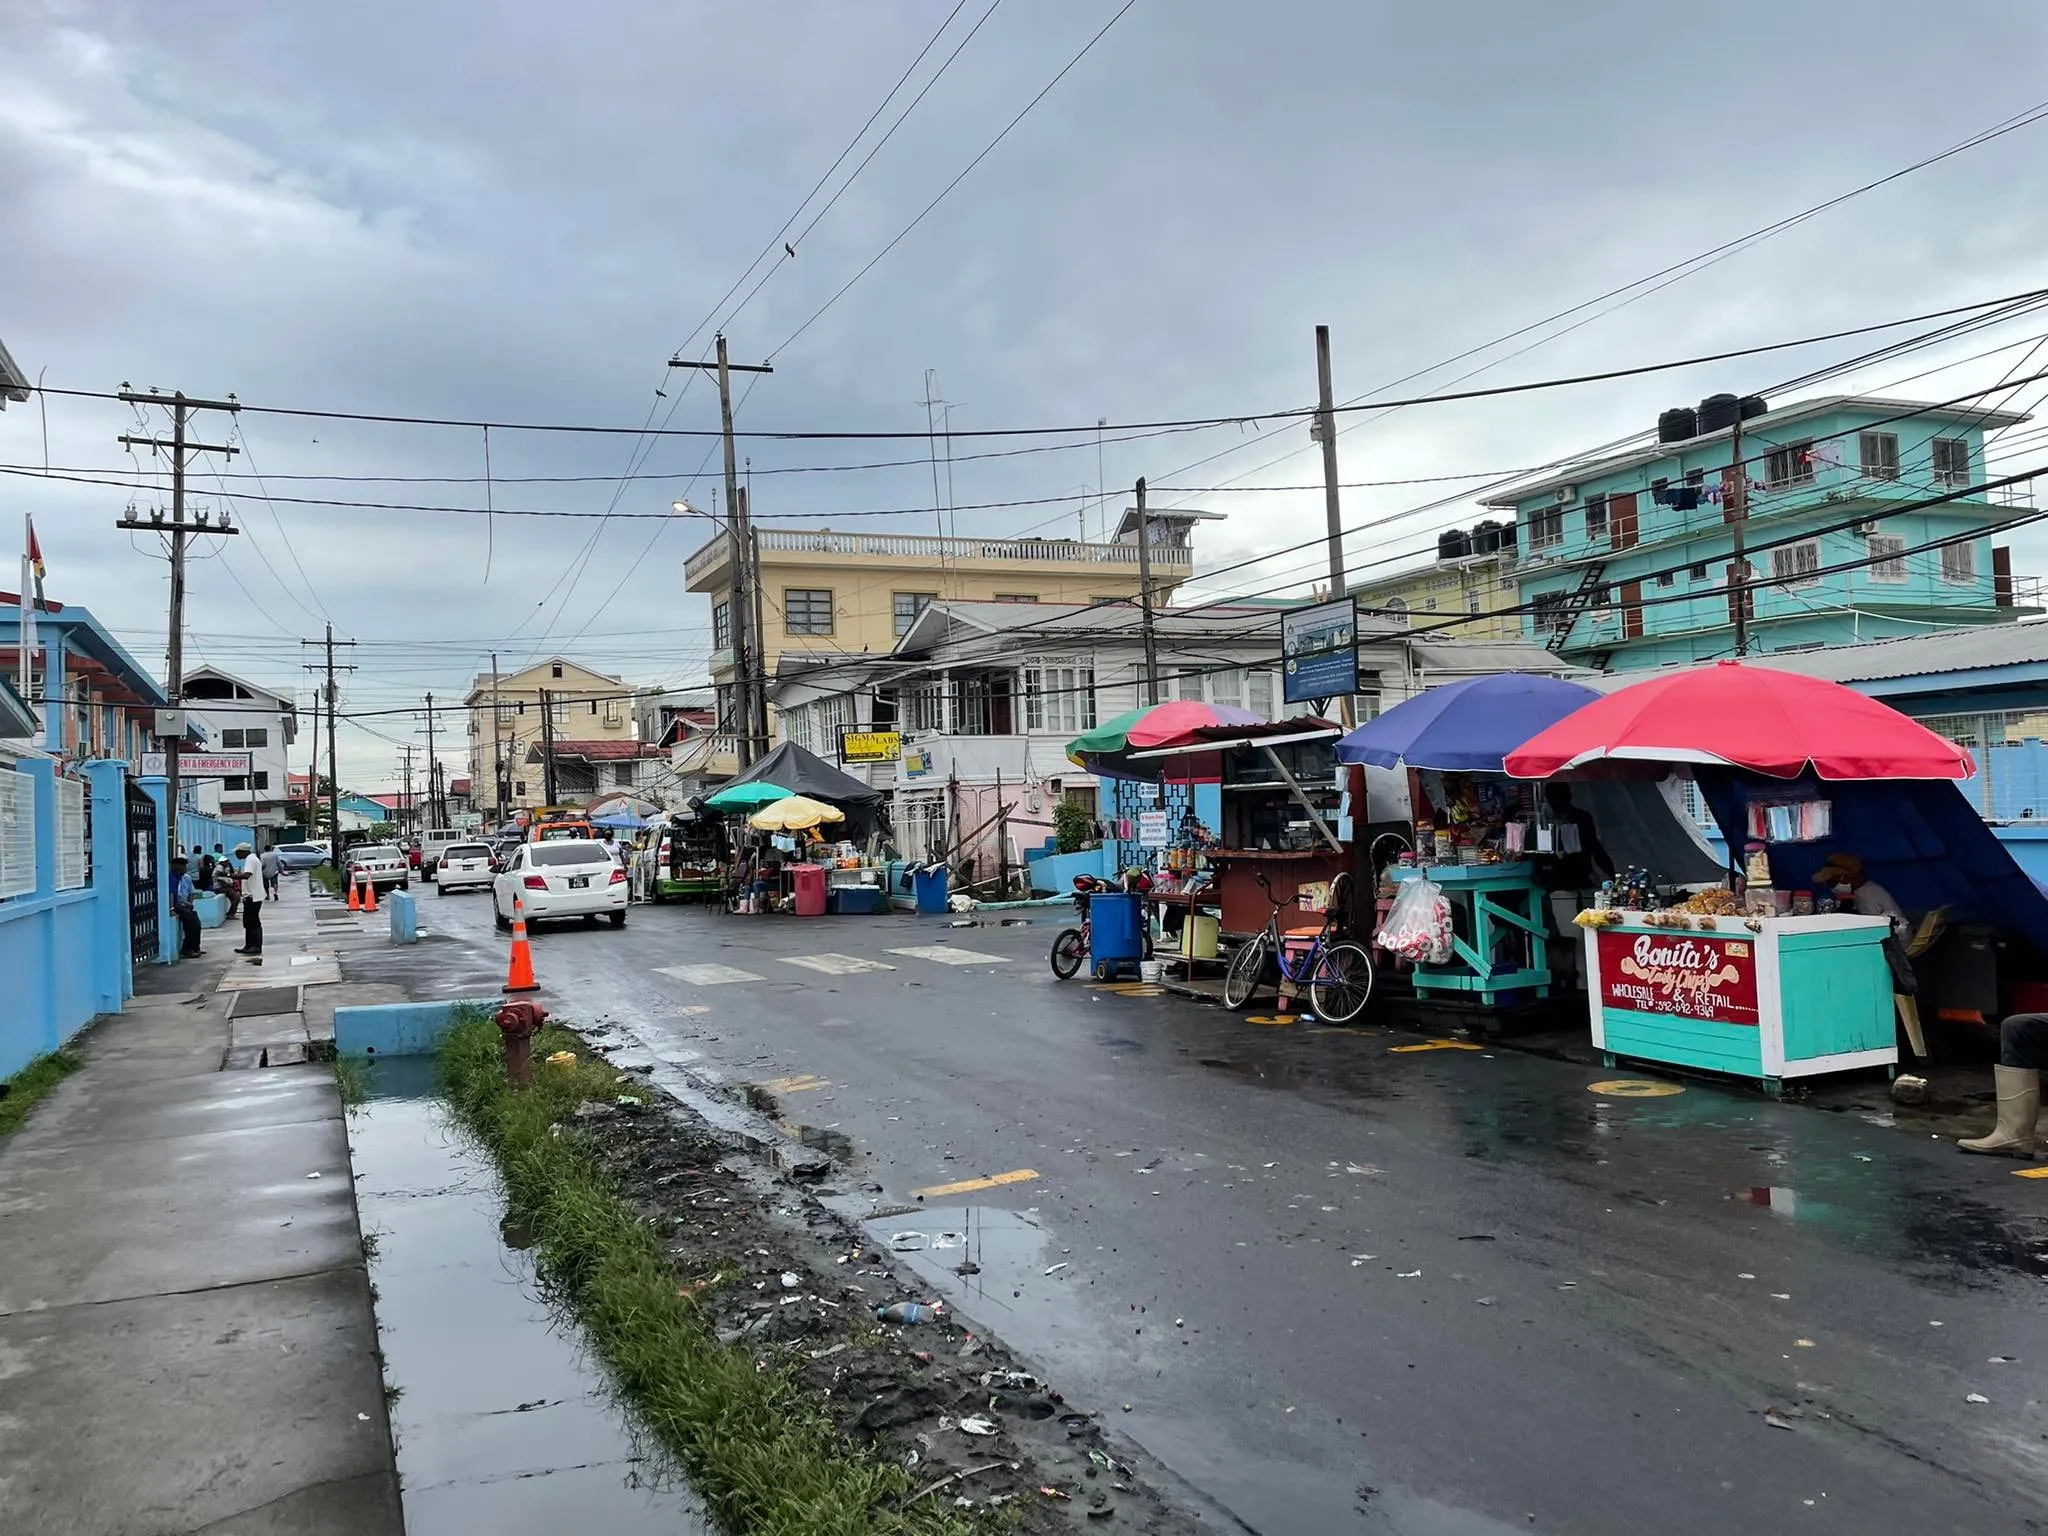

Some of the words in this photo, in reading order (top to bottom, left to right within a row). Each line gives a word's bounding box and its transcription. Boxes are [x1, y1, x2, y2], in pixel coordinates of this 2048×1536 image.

[846, 734, 875, 742] SIGMA
[875, 736, 898, 744] LABS
[192, 759, 197, 768] &
[198, 759, 231, 768] EMERGENCY
[1634, 934, 1719, 970] Bonita's
[1648, 966, 1676, 994] Tasty
[1676, 969, 1711, 997] Chips
[1611, 983, 1654, 1001] WHOLESALE
[1673, 988, 1685, 1003] &
